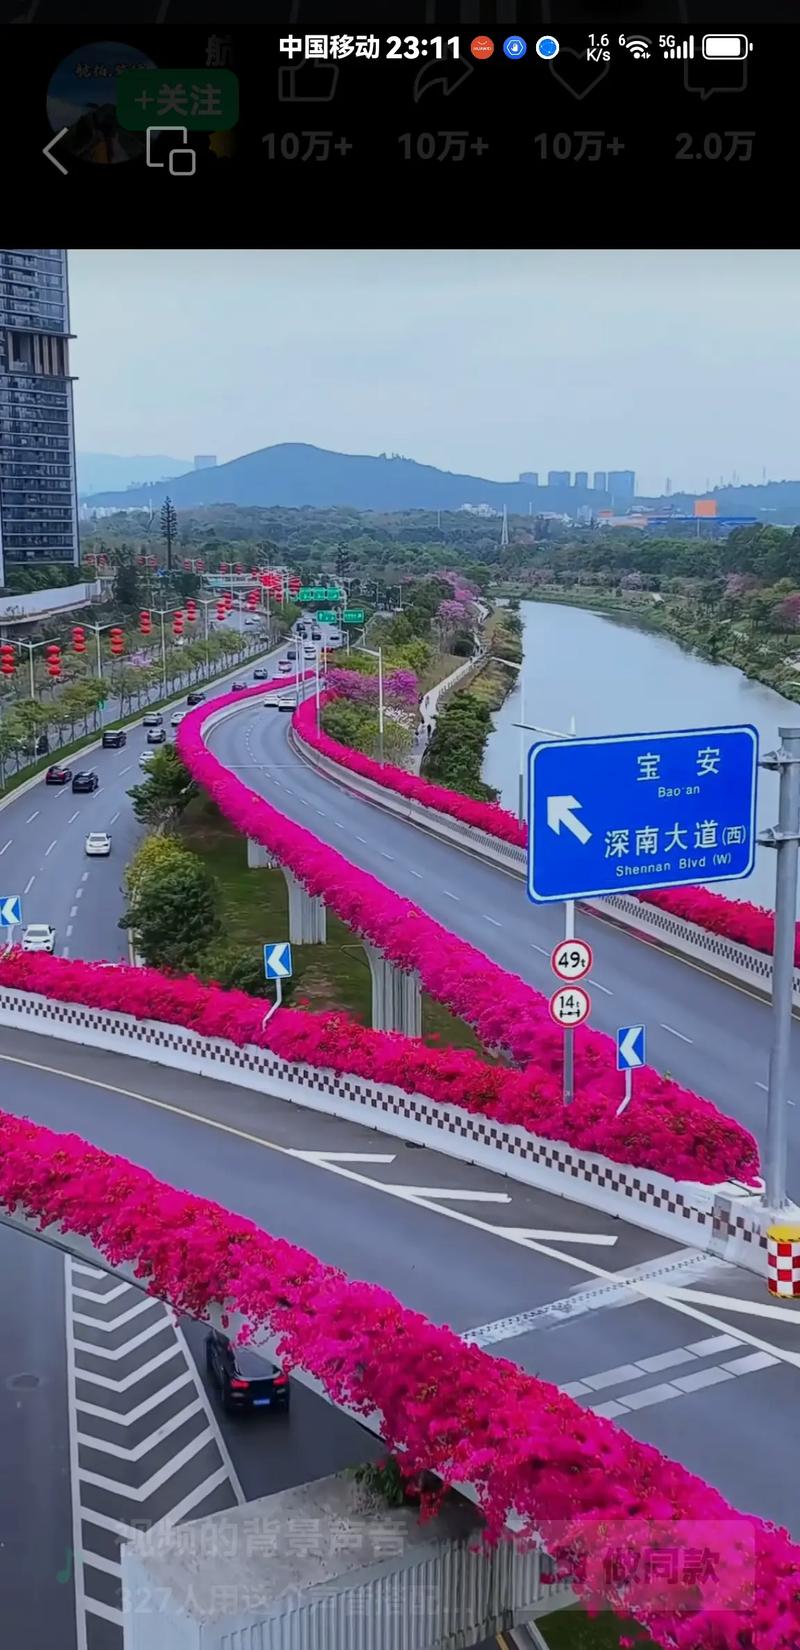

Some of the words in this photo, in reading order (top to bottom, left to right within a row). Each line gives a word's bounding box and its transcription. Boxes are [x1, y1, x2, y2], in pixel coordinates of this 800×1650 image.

[636, 746, 722, 782] 宝安
[603, 819, 746, 859] 深南大道(西)
[615, 860, 671, 877] Shennan
[679, 857, 706, 870] Blvd
[712, 853, 732, 866] (W)
[558, 951, 587, 968] 49t
